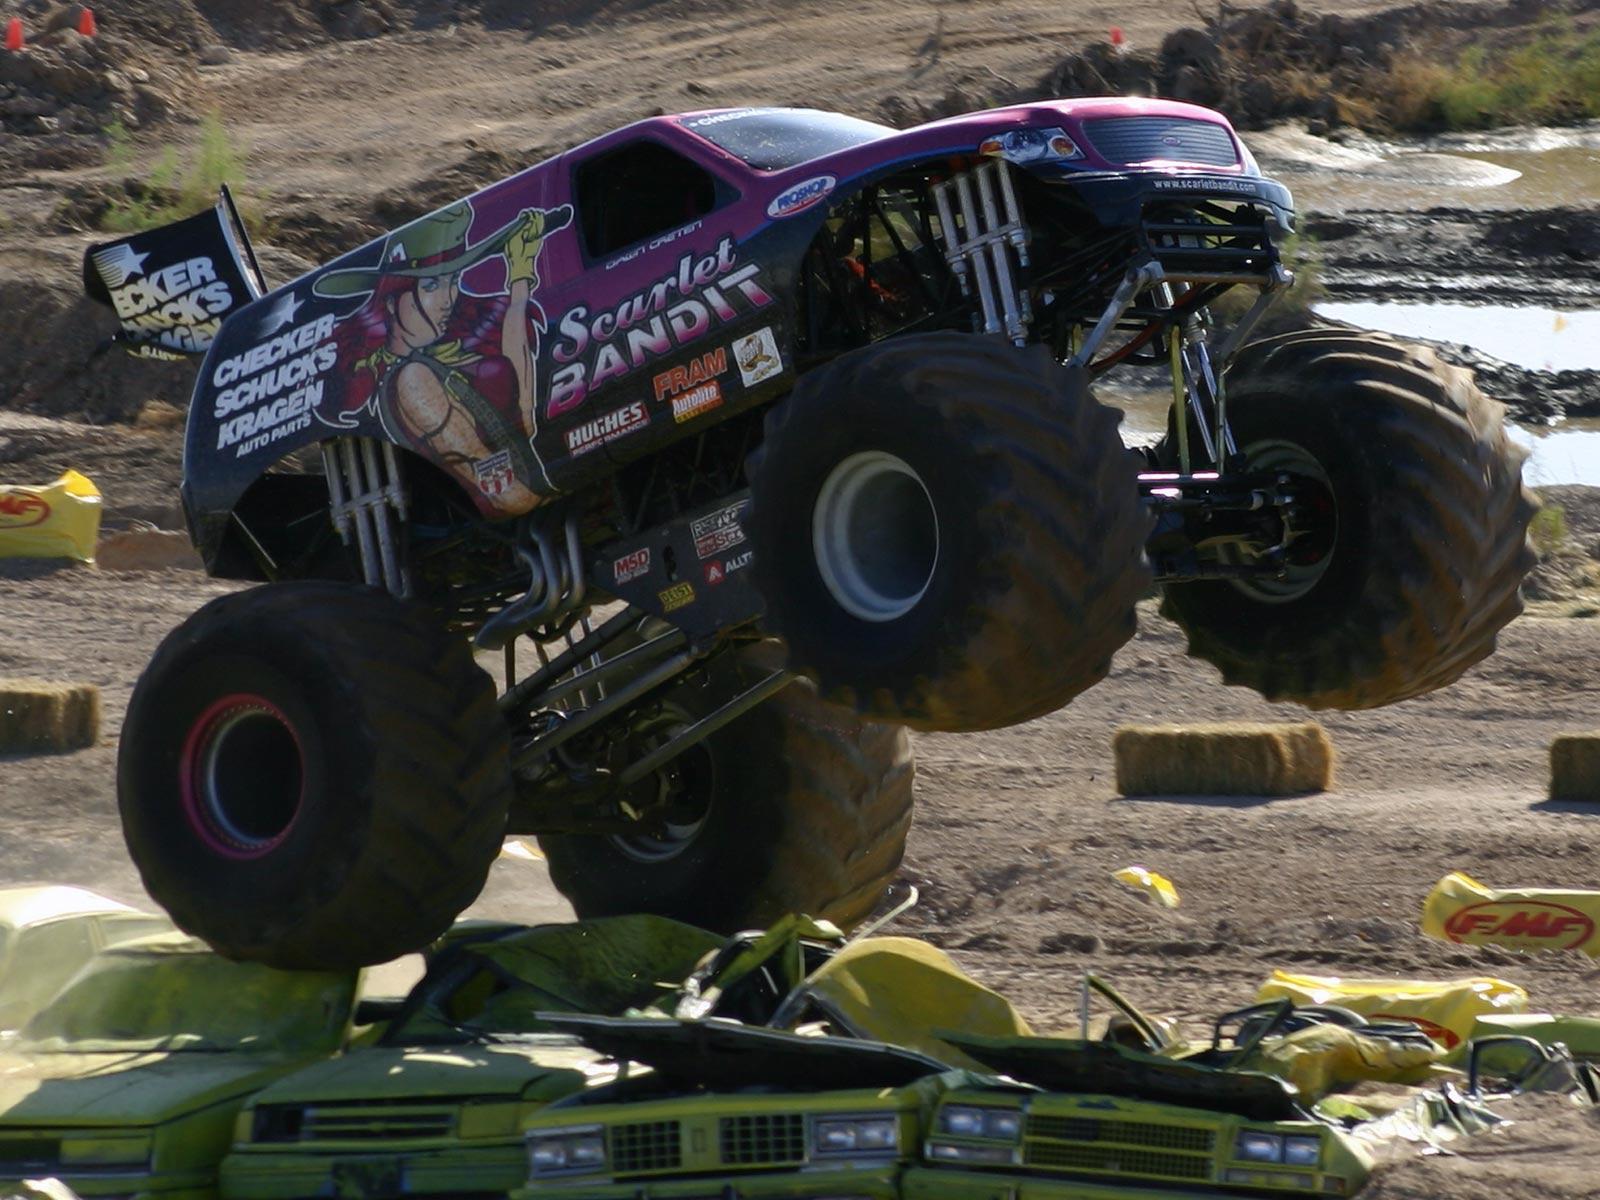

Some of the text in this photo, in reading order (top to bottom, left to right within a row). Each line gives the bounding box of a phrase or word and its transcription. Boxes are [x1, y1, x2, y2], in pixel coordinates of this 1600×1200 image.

[552, 237, 737, 362] Scarlet
[214, 314, 335, 387] CHECKER
[546, 263, 774, 420] BANDIT
[652, 346, 729, 402] FRAM
[216, 380, 325, 451] KRAGEN
[236, 413, 311, 458] AUTO PARTS
[567, 402, 643, 449] HUGHES
[615, 551, 649, 576] MSD
[1451, 911, 1588, 938] FMF
